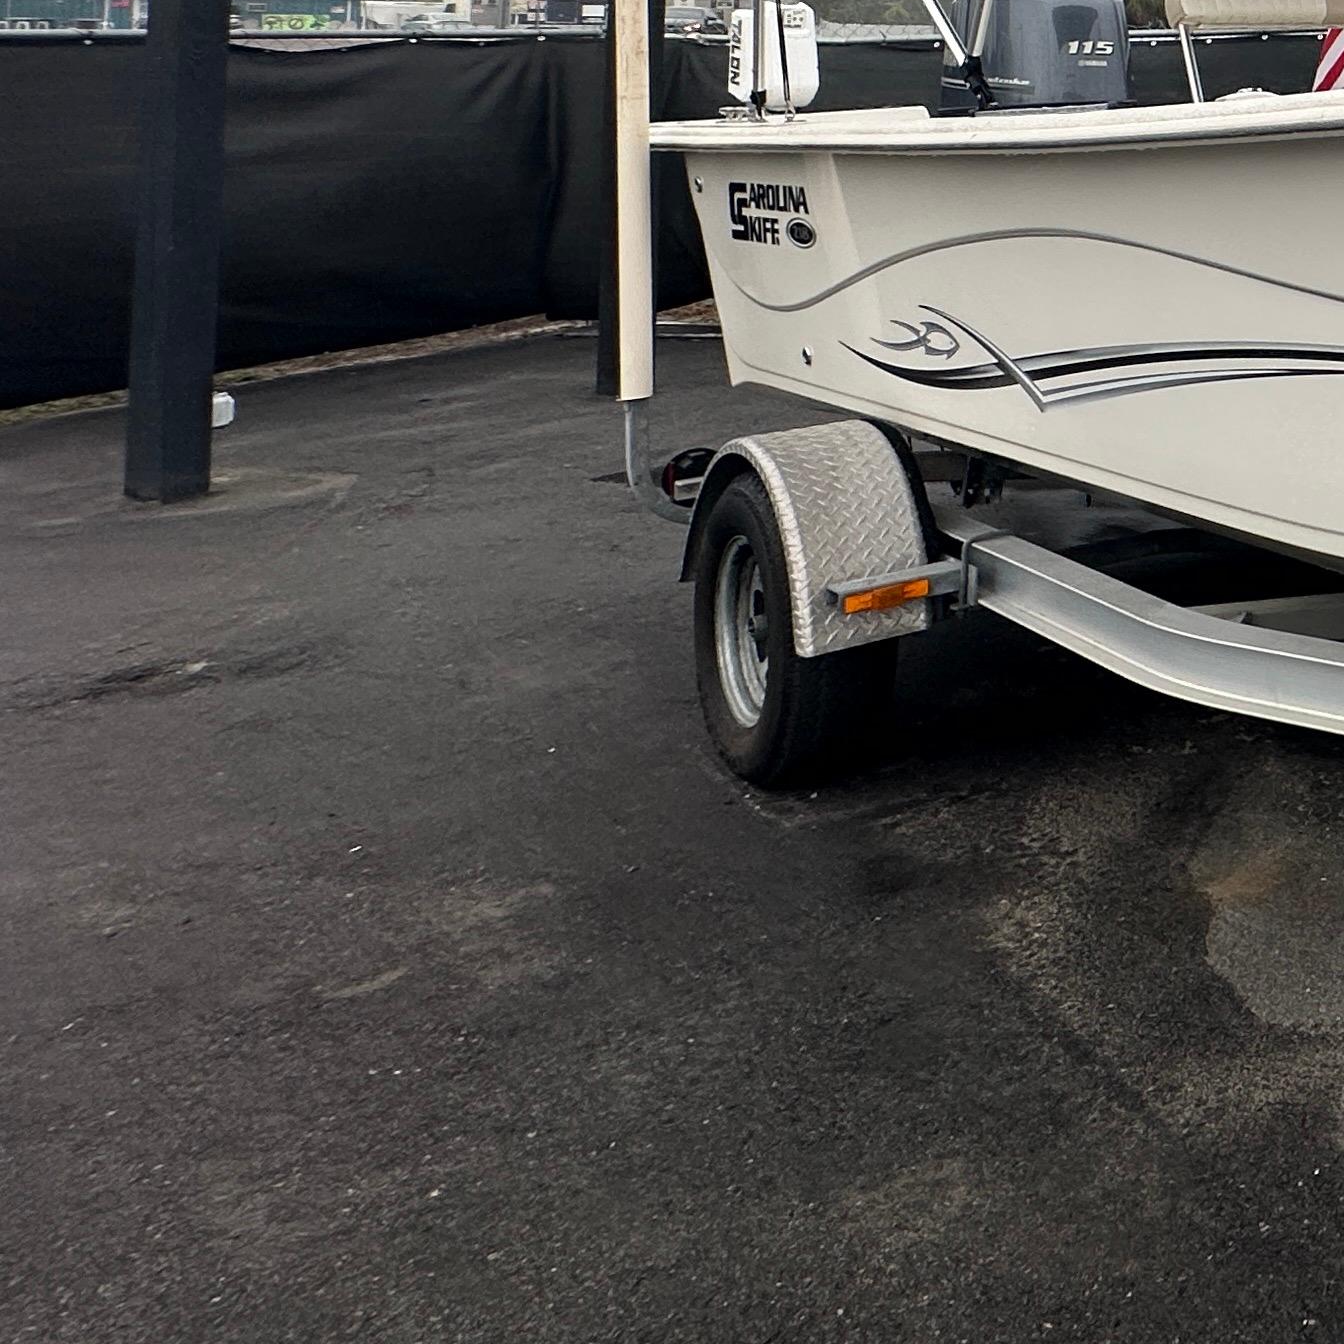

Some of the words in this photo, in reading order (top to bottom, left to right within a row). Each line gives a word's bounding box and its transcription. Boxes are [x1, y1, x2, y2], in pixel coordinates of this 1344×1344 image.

[729, 19, 743, 86] TALON
[1068, 40, 1115, 55] 115
[728, 182, 810, 225] CAROLINA
